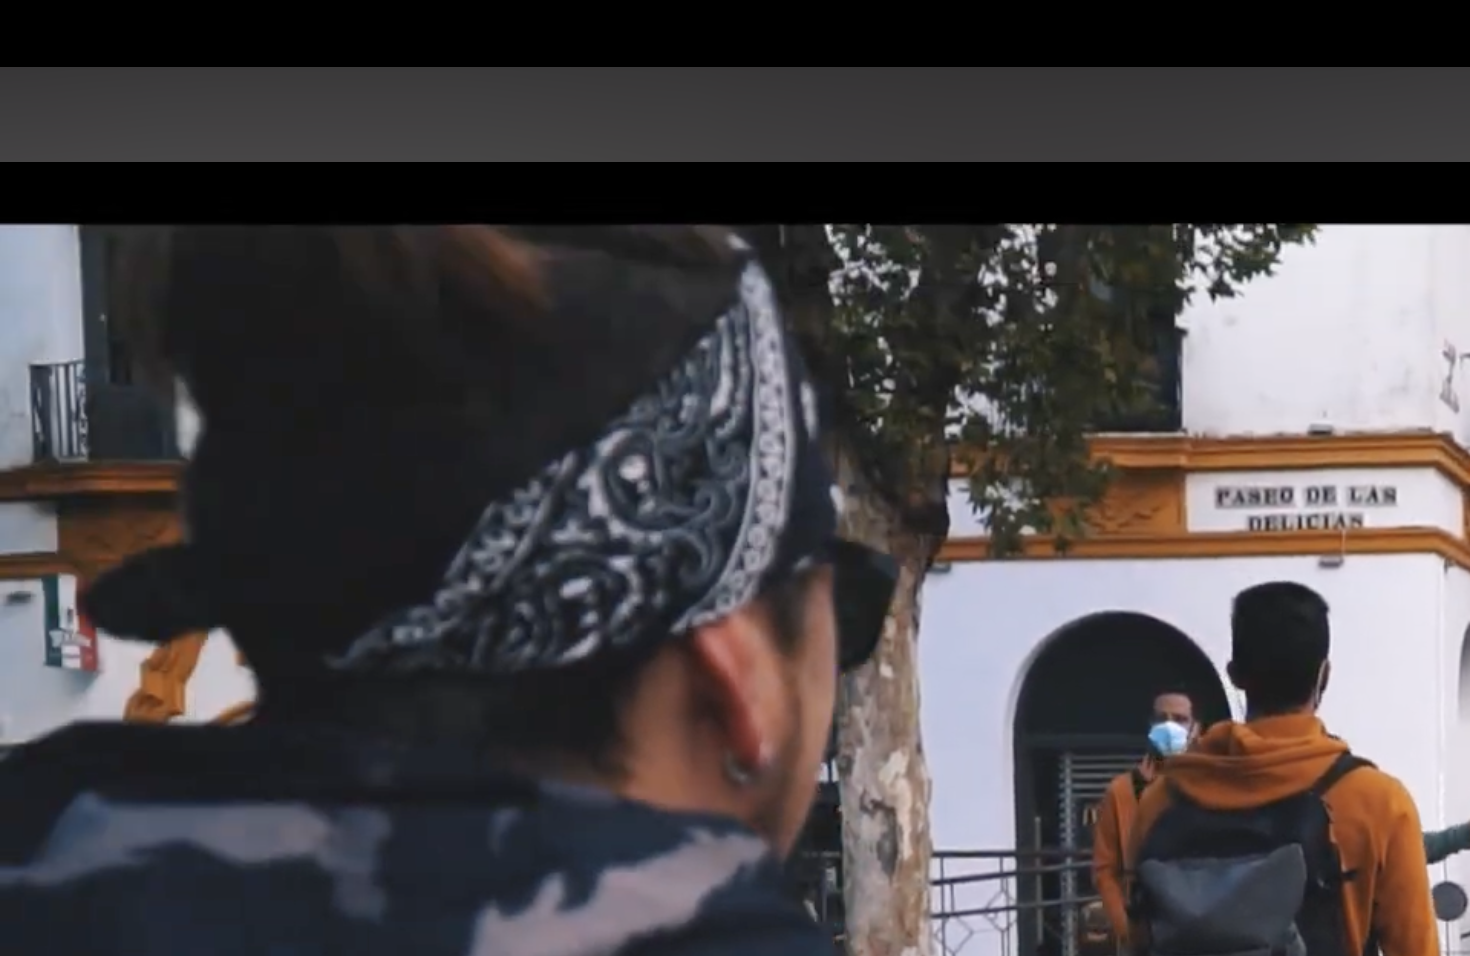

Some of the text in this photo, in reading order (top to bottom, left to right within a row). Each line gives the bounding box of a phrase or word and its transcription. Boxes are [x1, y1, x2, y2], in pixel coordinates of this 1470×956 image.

[1216, 486, 1397, 507] PASEO DE LAS
[1249, 513, 1364, 531] DELICIAS
